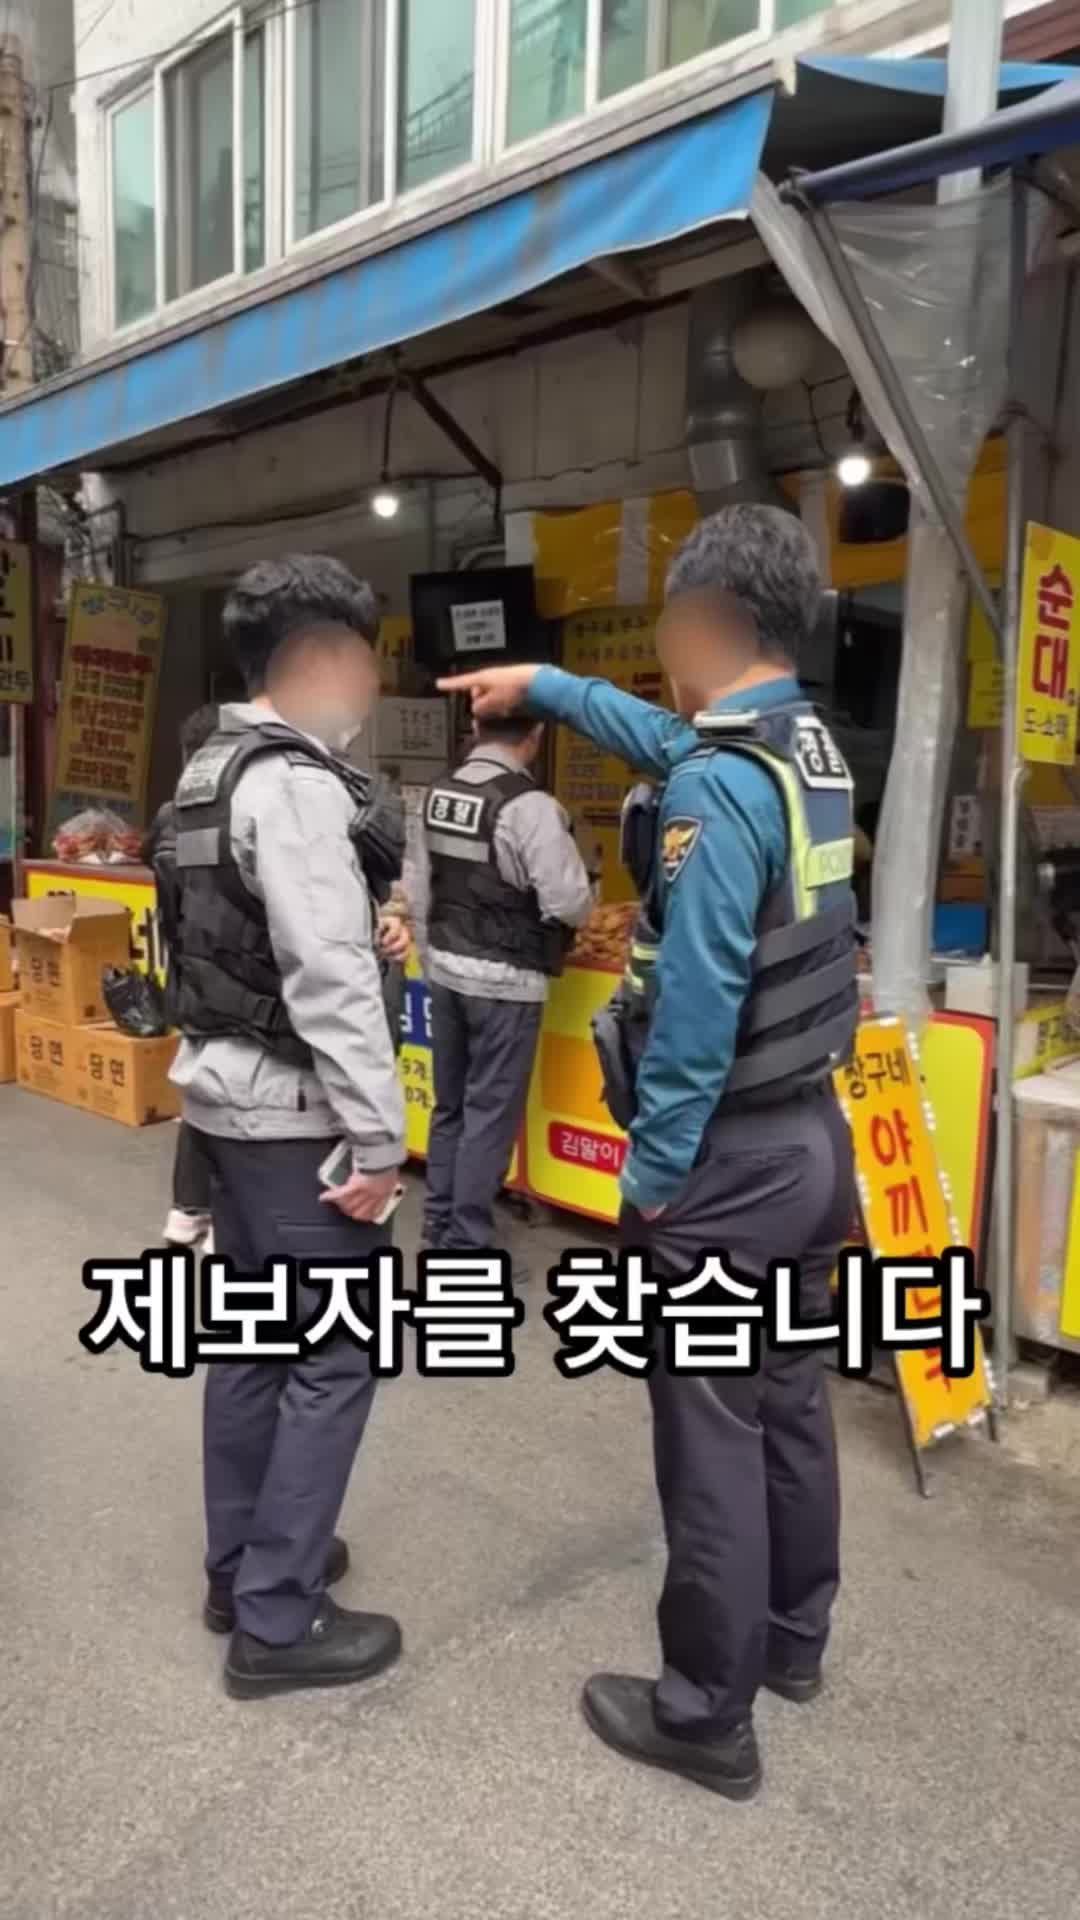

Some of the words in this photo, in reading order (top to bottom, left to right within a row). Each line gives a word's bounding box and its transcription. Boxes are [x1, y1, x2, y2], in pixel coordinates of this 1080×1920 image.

[1032, 563, 1074, 700] 순대
[434, 797, 472, 825] 경찰
[31, 1035, 65, 1067] 당면
[89, 1052, 126, 1087] 당면
[561, 1131, 619, 1168] 김말이
